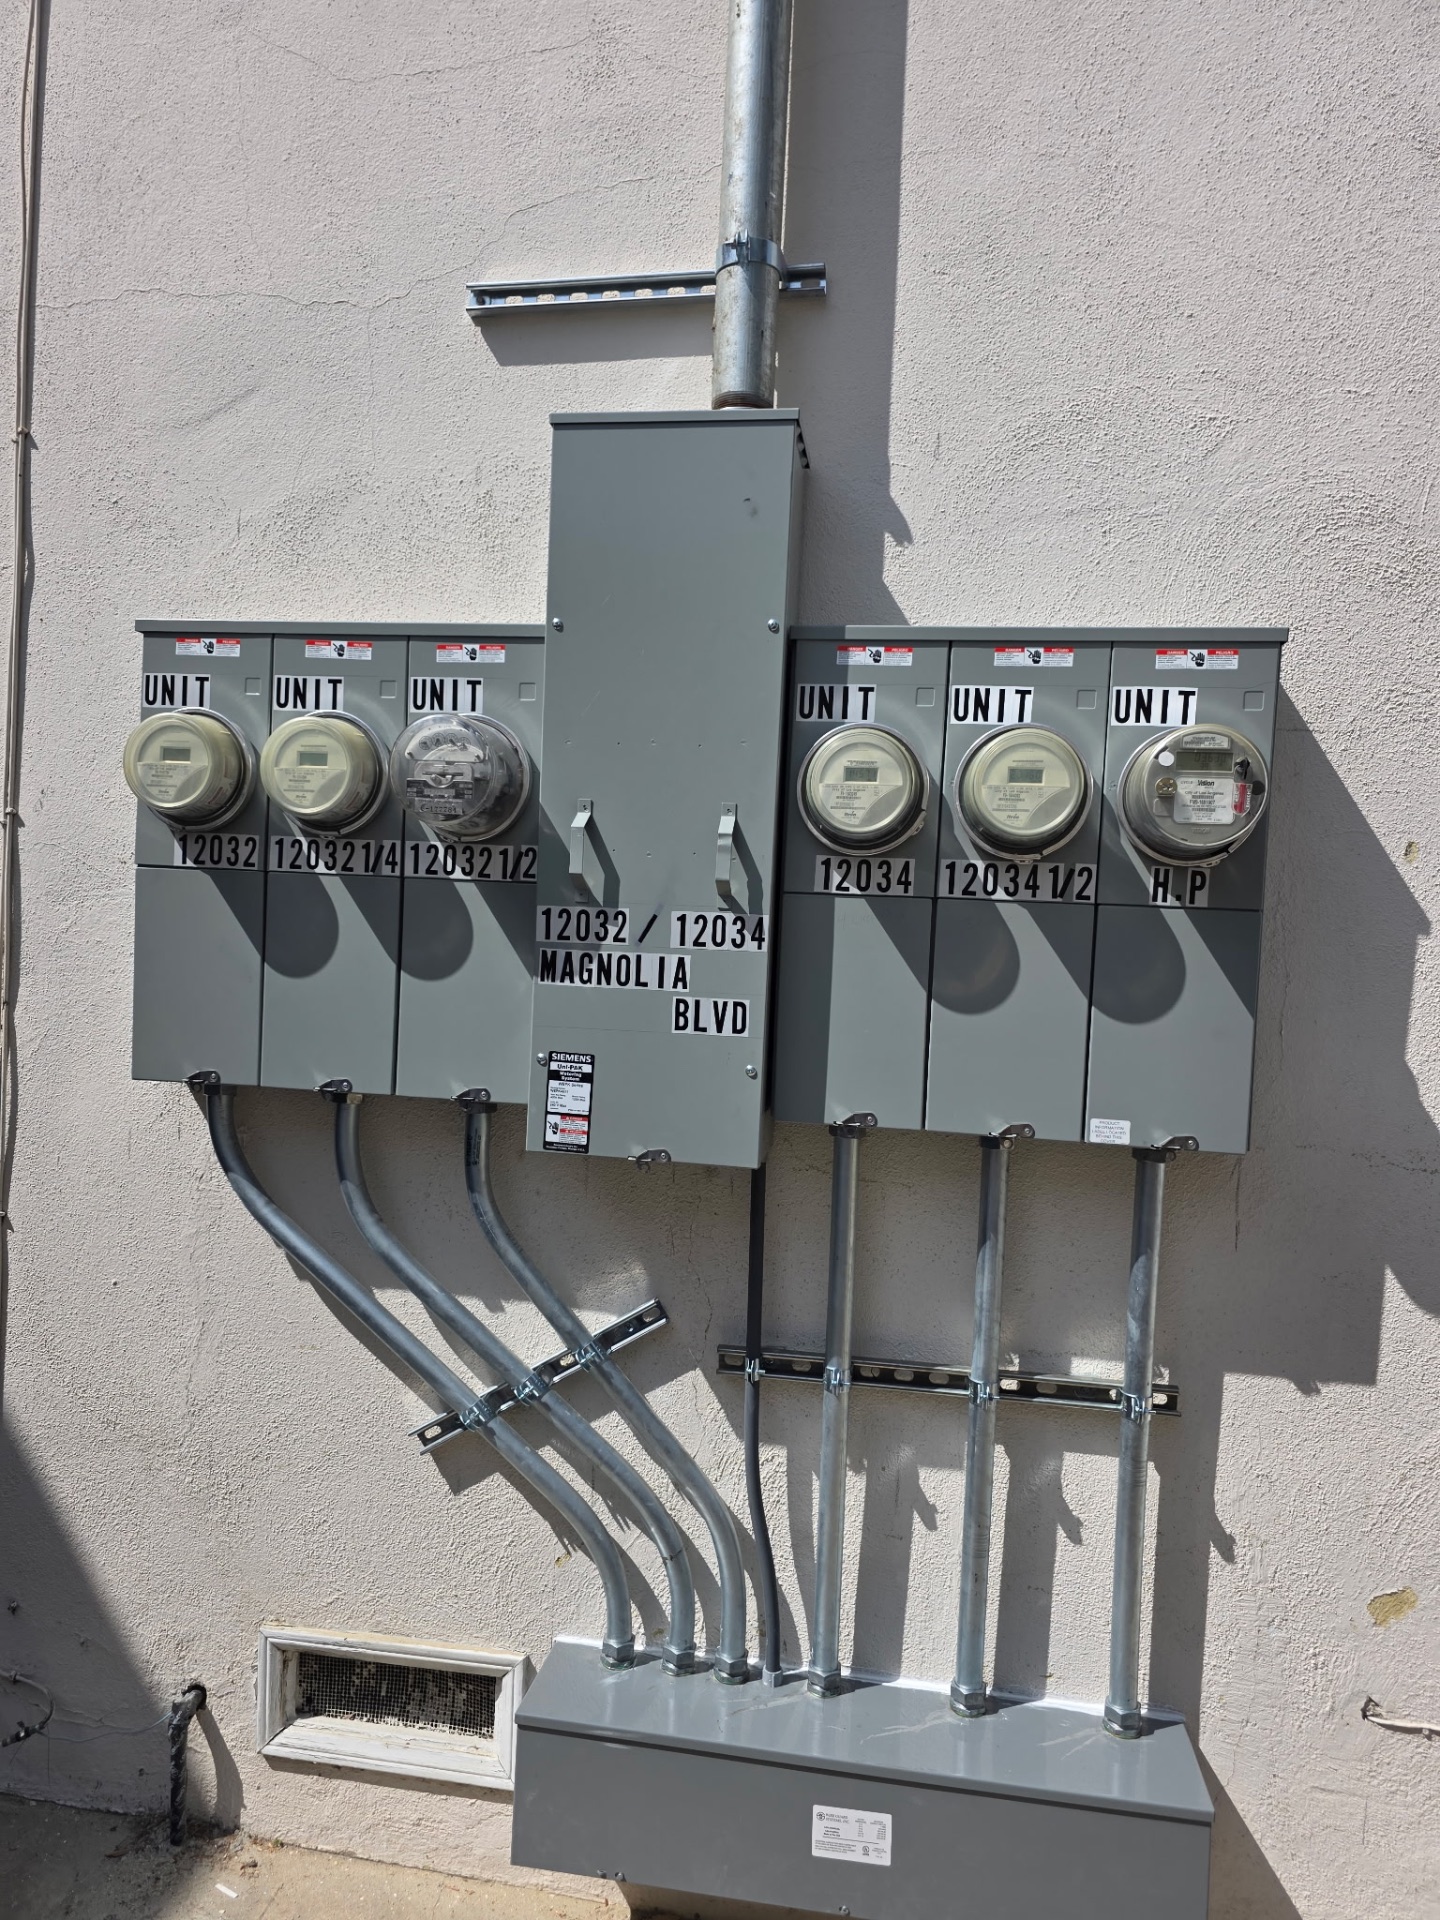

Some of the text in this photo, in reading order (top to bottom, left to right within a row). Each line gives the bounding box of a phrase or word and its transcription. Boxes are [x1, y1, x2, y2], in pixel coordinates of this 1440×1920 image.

[145, 674, 209, 707] UNIT
[276, 677, 342, 710] UNIT
[412, 678, 481, 712] UNIT
[799, 685, 875, 720] UNIT
[954, 687, 1033, 723] UNIT
[1114, 688, 1196, 725] UNIT
[178, 834, 257, 868] 12032
[820, 857, 912, 894] 12034
[1152, 867, 1207, 905] H.P
[541, 907, 766, 950] 12032 / 12034
[540, 949, 688, 990] MAGNOLIA
[674, 997, 747, 1035] BLVD
[552, 1053, 592, 1063] SIEMENS
